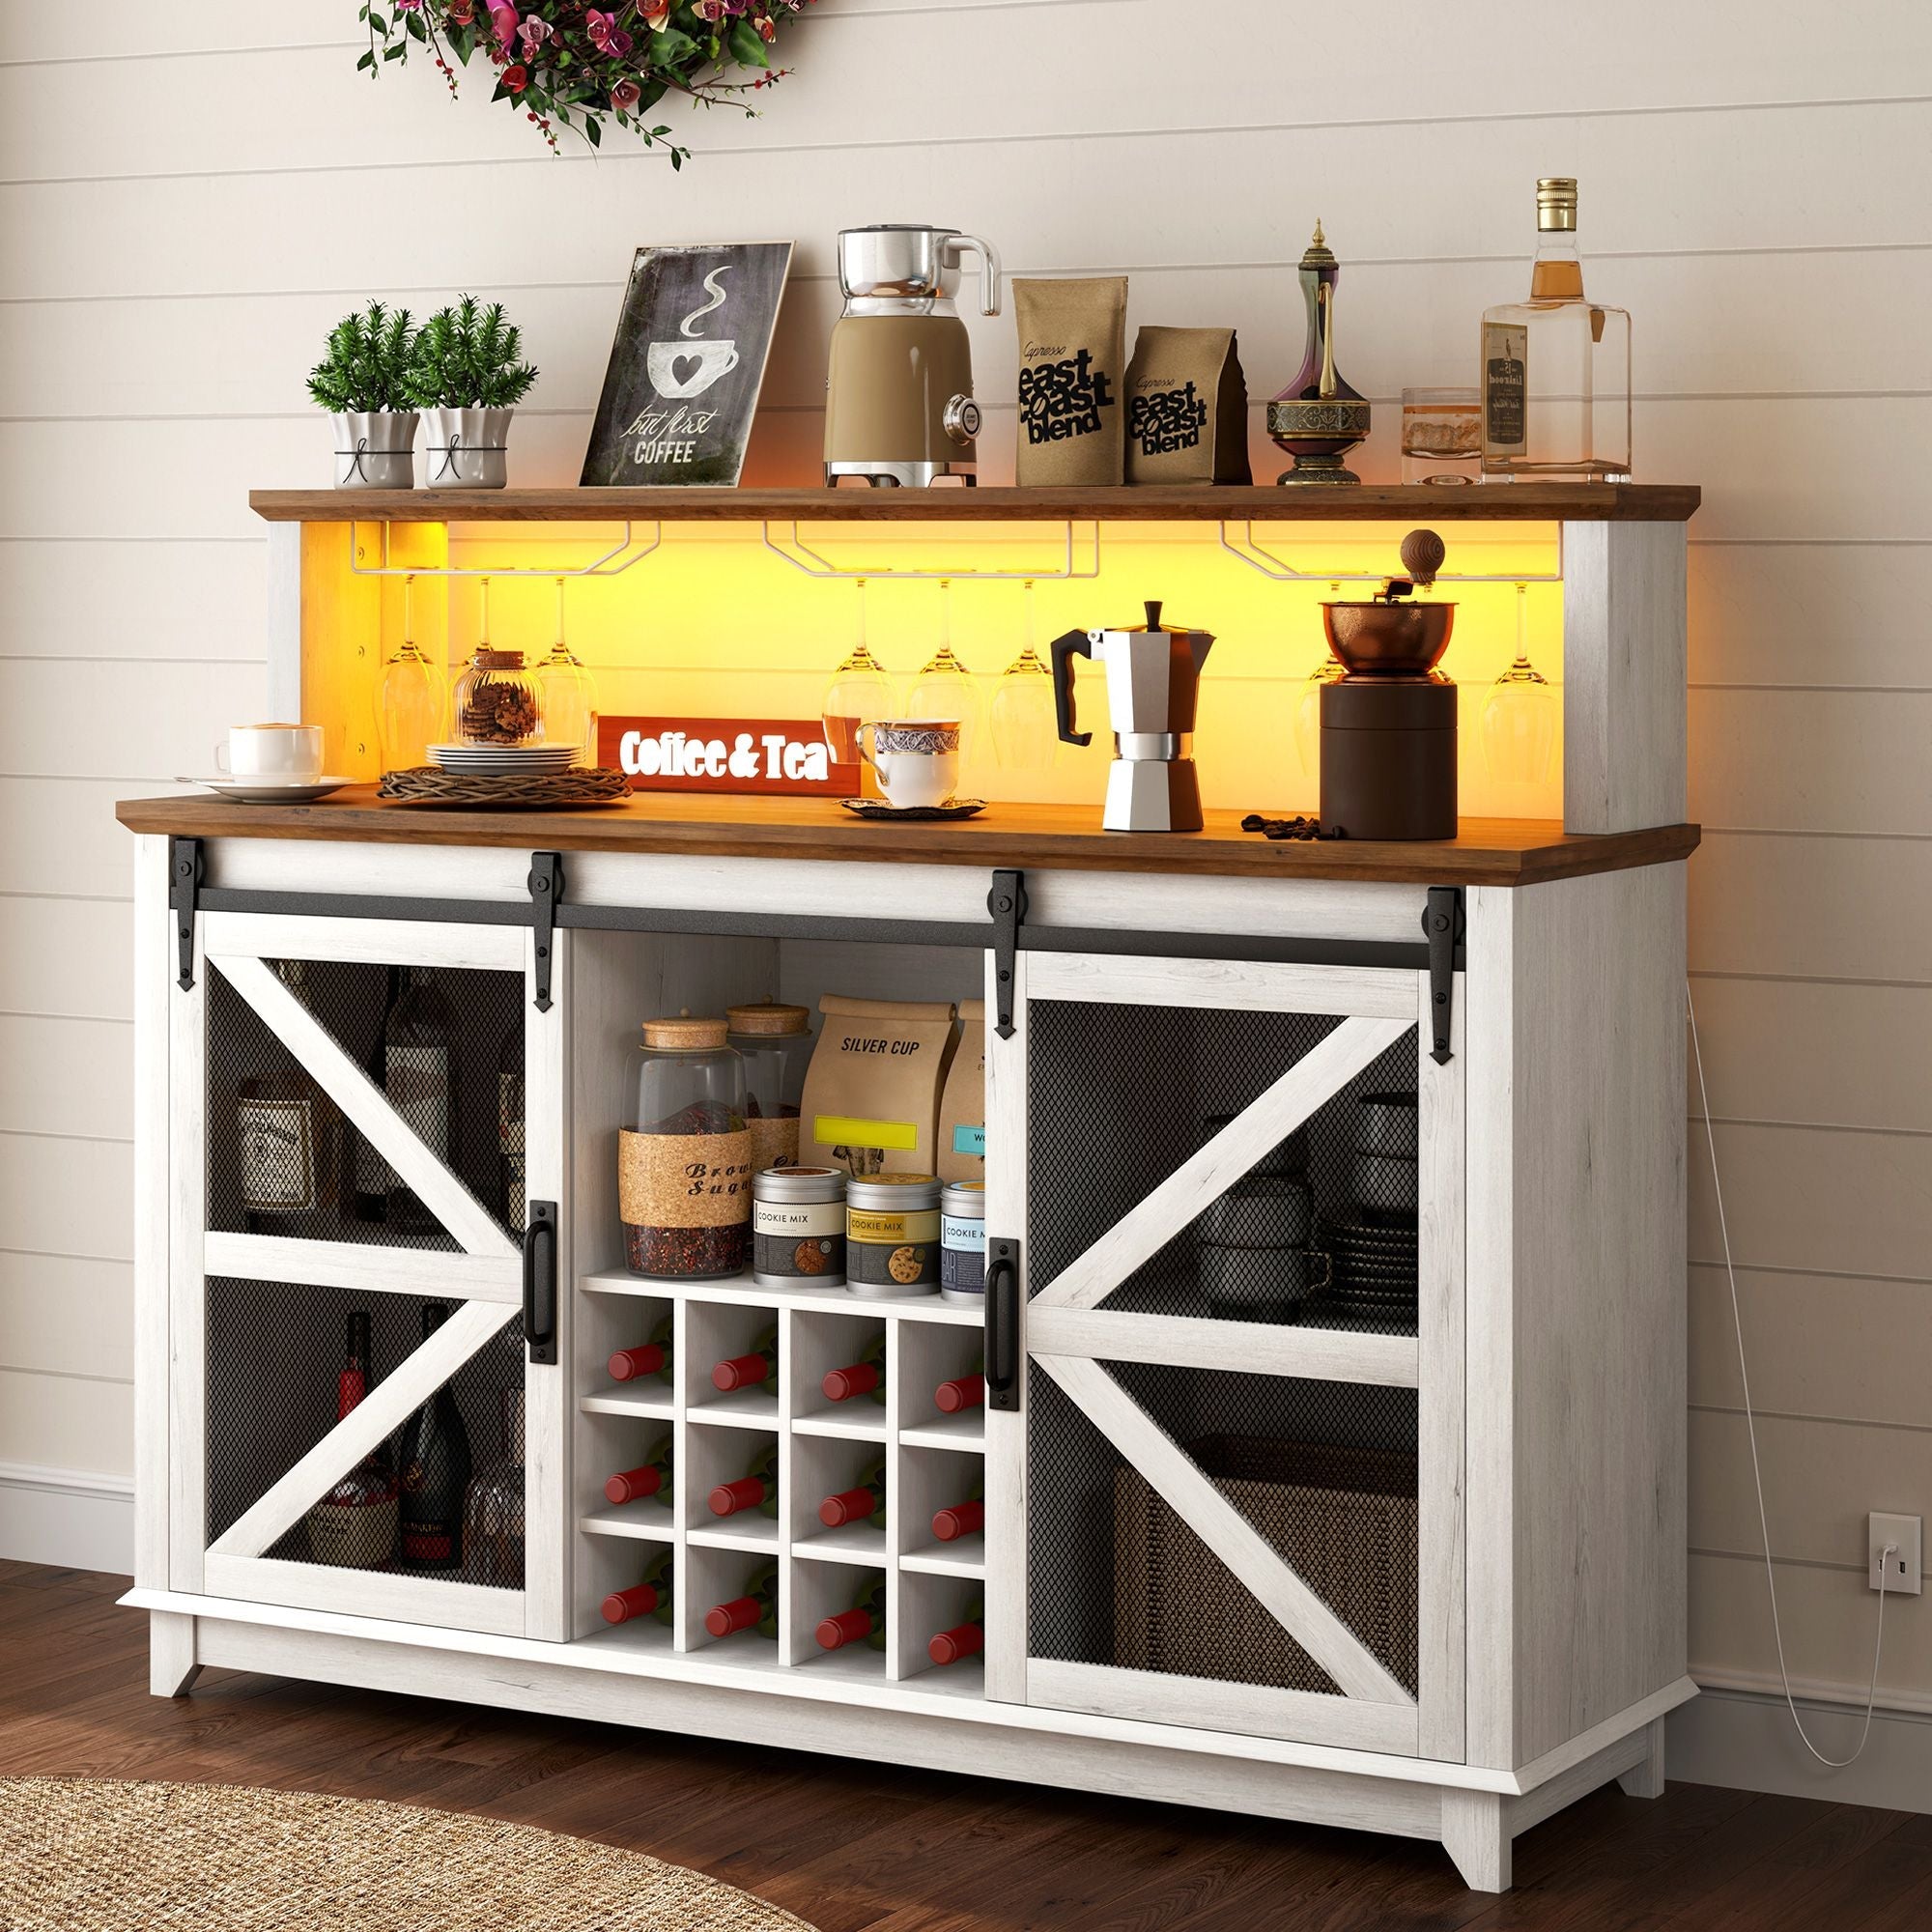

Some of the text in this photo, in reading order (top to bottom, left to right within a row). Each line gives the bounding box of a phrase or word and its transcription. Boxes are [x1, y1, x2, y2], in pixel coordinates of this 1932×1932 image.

[1019, 349, 1094, 396] east
[1019, 371, 1115, 423] coast
[1131, 381, 1197, 417] east
[618, 404, 721, 442] but first
[1028, 405, 1102, 445] blend
[1129, 398, 1207, 440] coast
[634, 440, 696, 465] COFFEE
[1142, 425, 1199, 456] blend
[619, 730, 829, 781] Coffee & Tea
[841, 1037, 920, 1055] SILVER CUP
[758, 1211, 809, 1223] COOKIE MIX
[851, 1219, 902, 1231] COOKIE MIX
[947, 1227, 978, 1238] COOKIE
